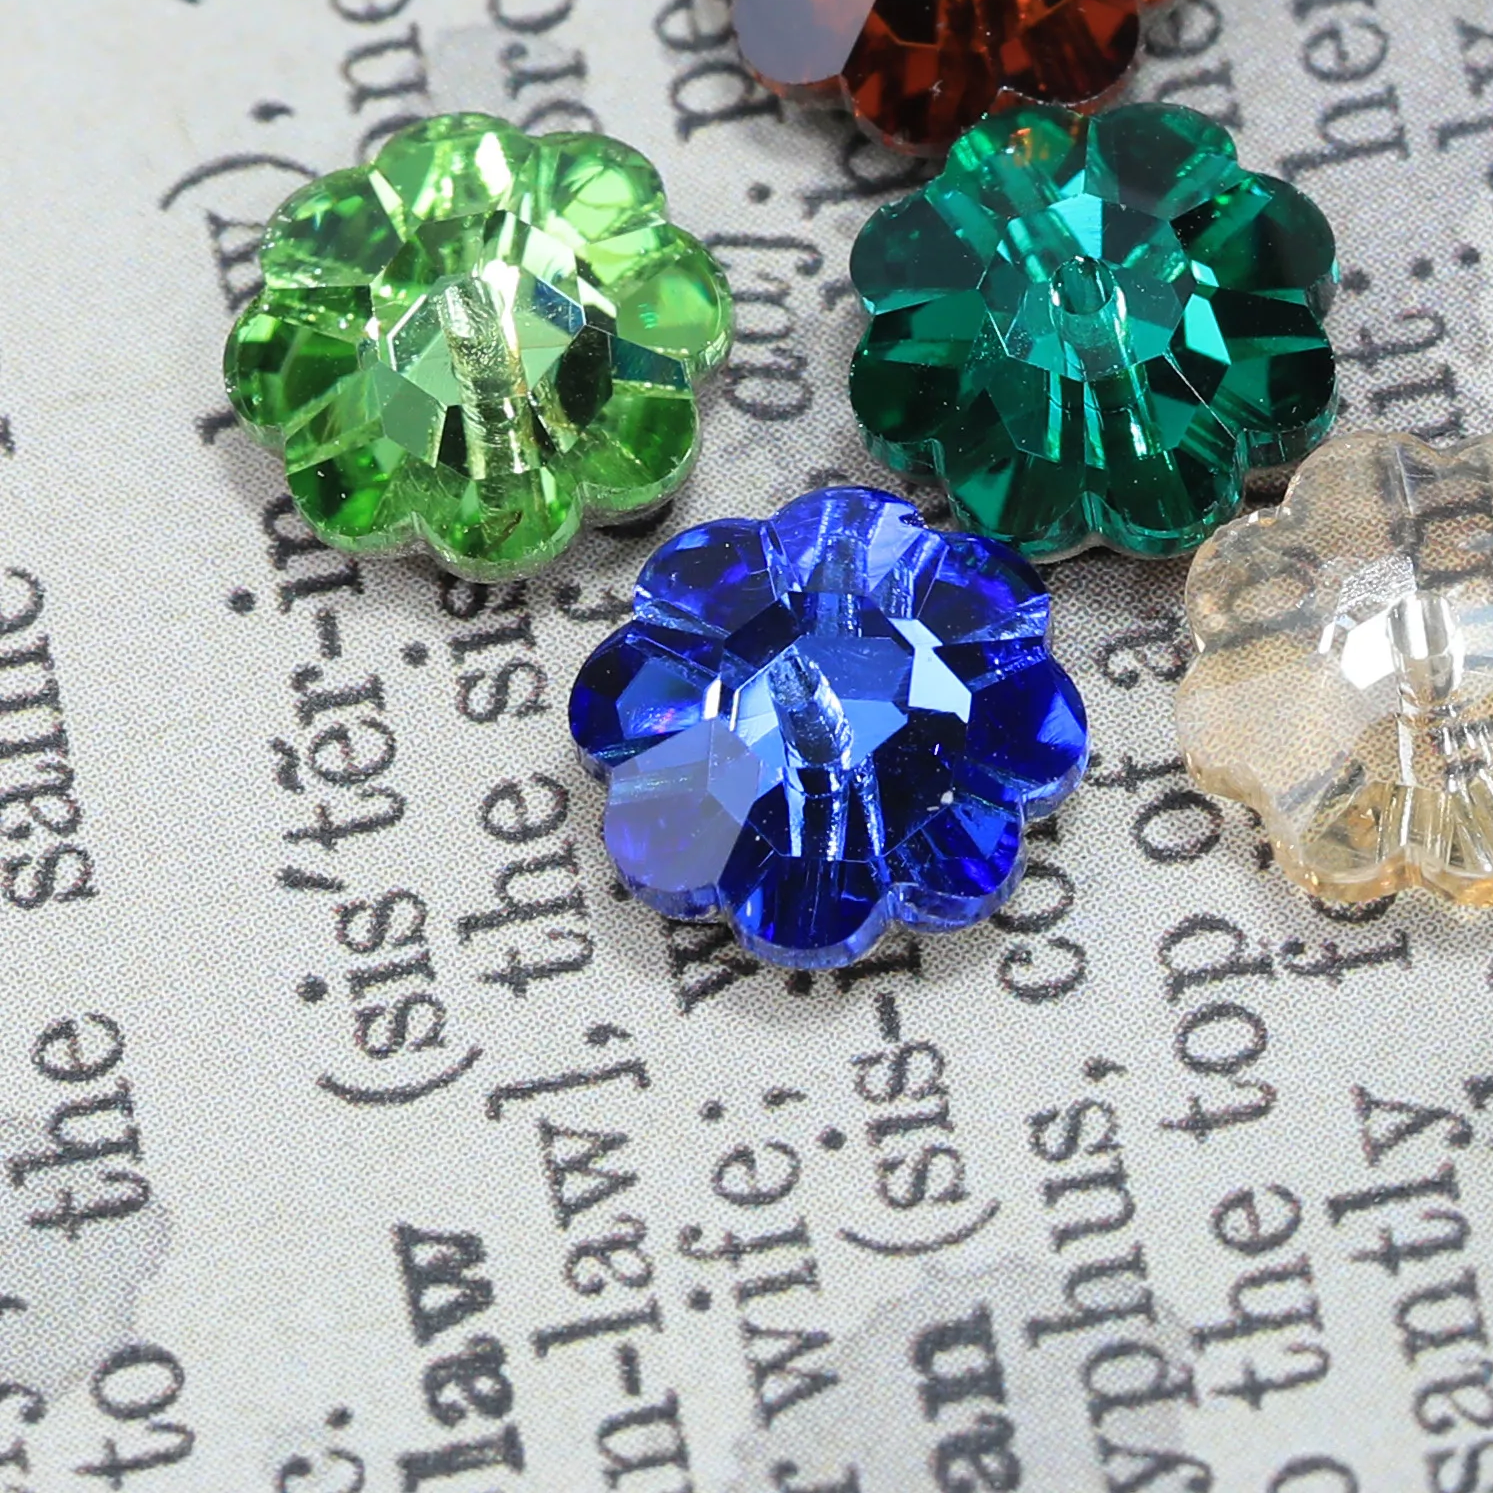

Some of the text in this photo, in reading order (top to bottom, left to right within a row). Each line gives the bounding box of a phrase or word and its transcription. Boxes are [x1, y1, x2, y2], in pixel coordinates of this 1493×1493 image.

[1102, 603, 1191, 687] a
[455, 763, 596, 998] the
[7, 1014, 152, 1238] the
[1158, 913, 1277, 1142] top
[485, 1023, 698, 1493] n-law],
[677, 1087, 842, 1421] wife;
[1188, 1184, 1331, 1410] the
[77, 1341, 196, 1490] to
